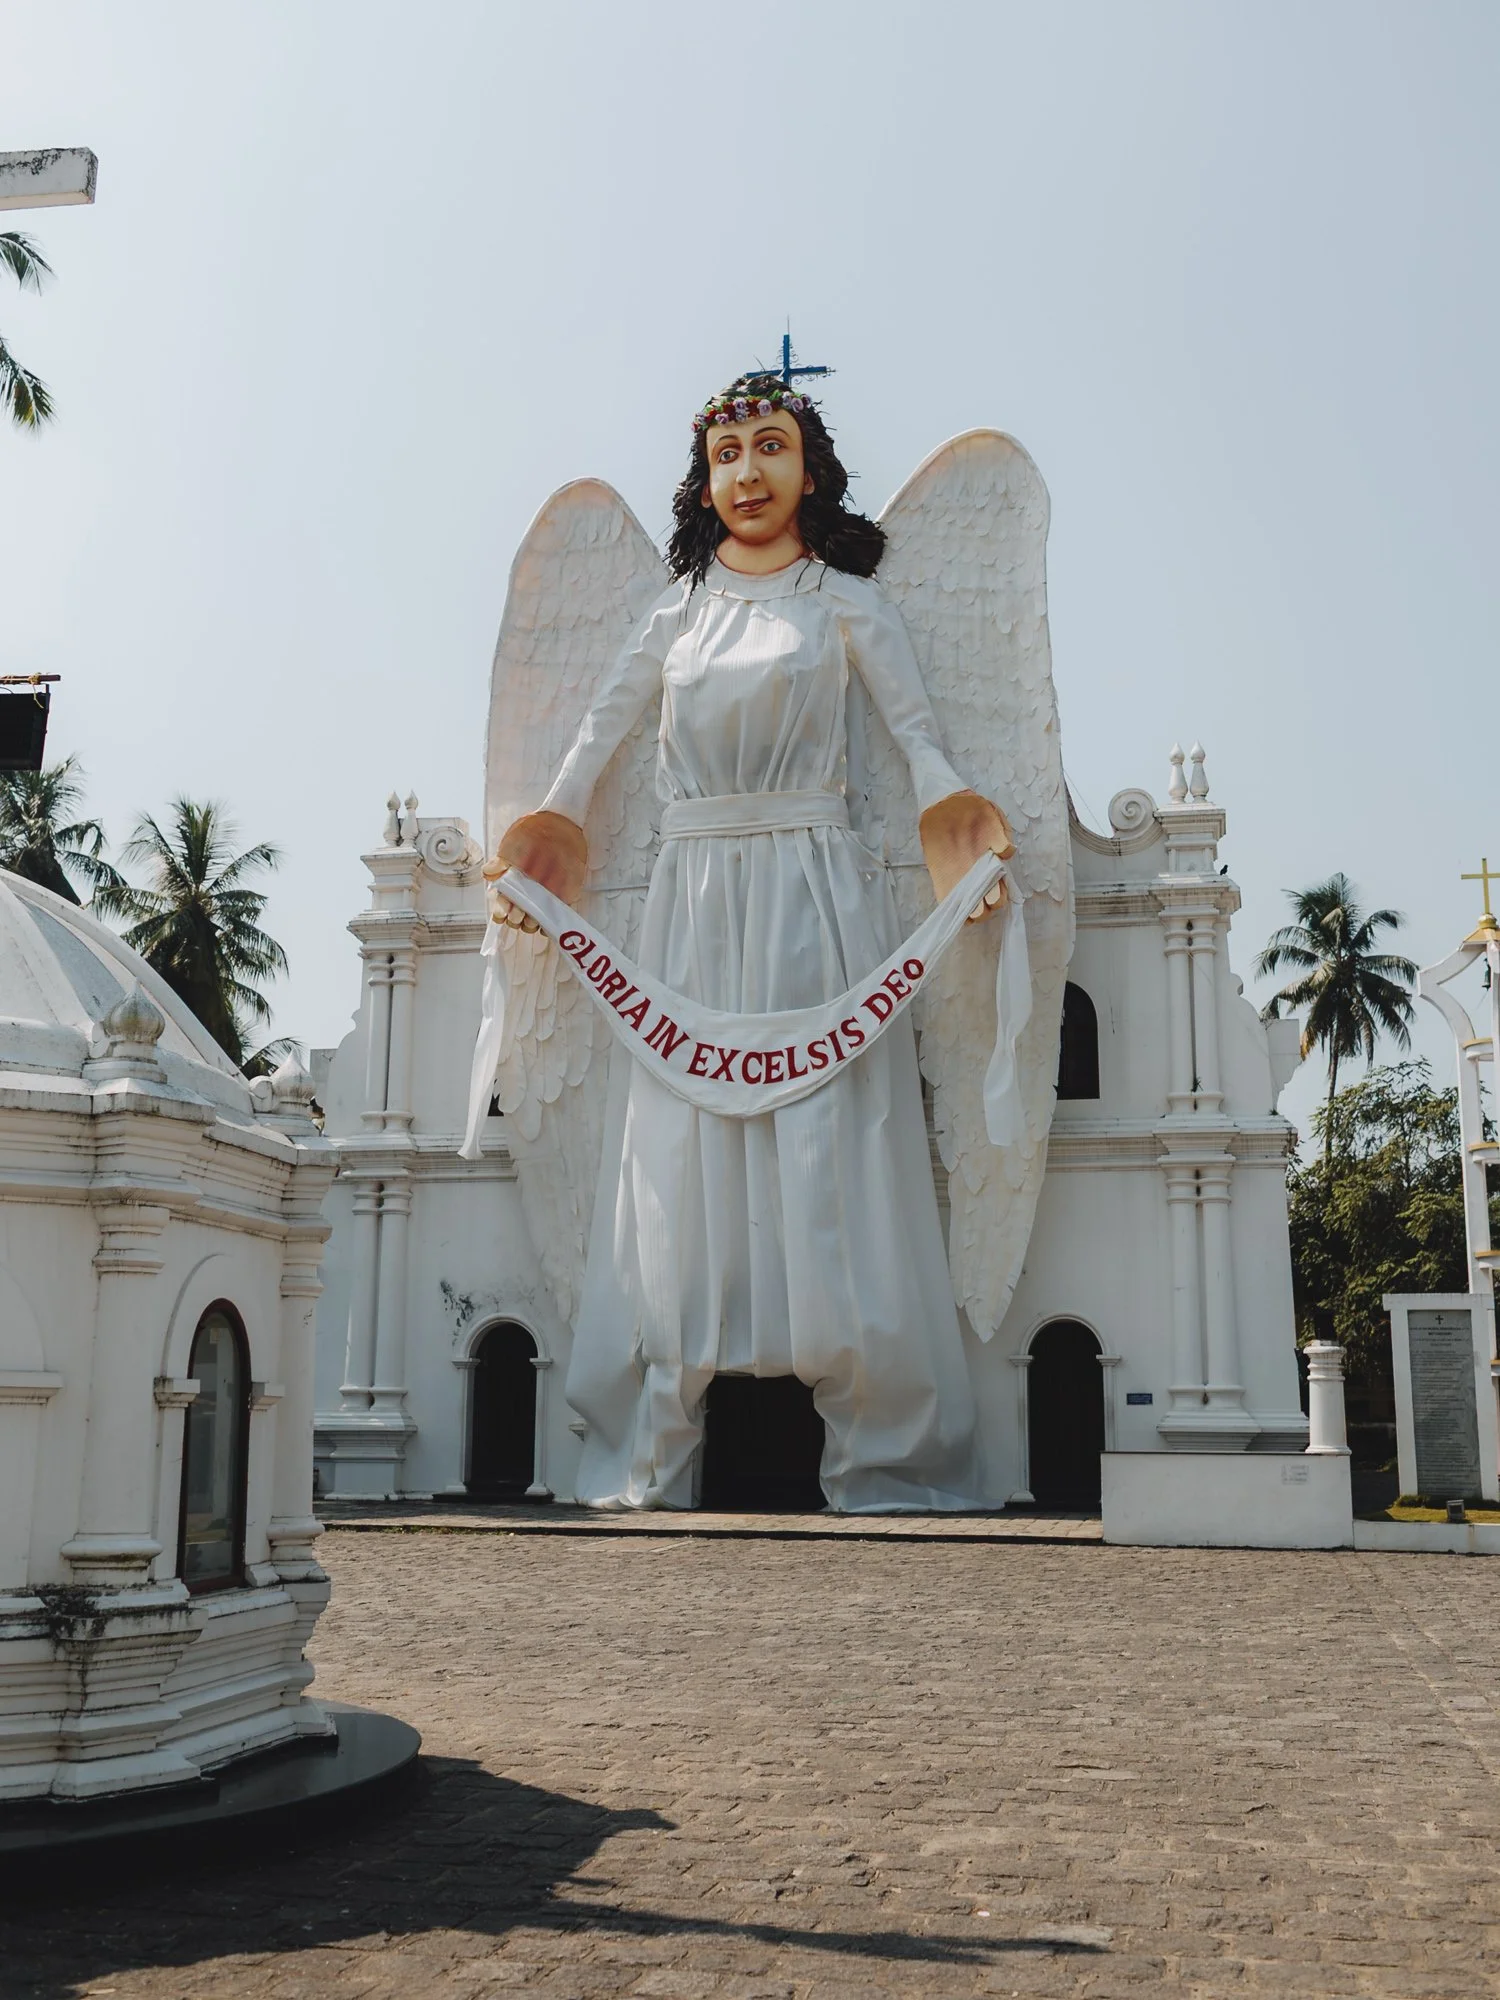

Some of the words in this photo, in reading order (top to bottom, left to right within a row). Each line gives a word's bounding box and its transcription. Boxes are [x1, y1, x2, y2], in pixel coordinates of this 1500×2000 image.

[559, 930, 651, 1031] GLORIA
[642, 1014, 690, 1061] IN
[687, 1016, 865, 1084] EXCELSIS
[861, 958, 925, 1024] DEO
